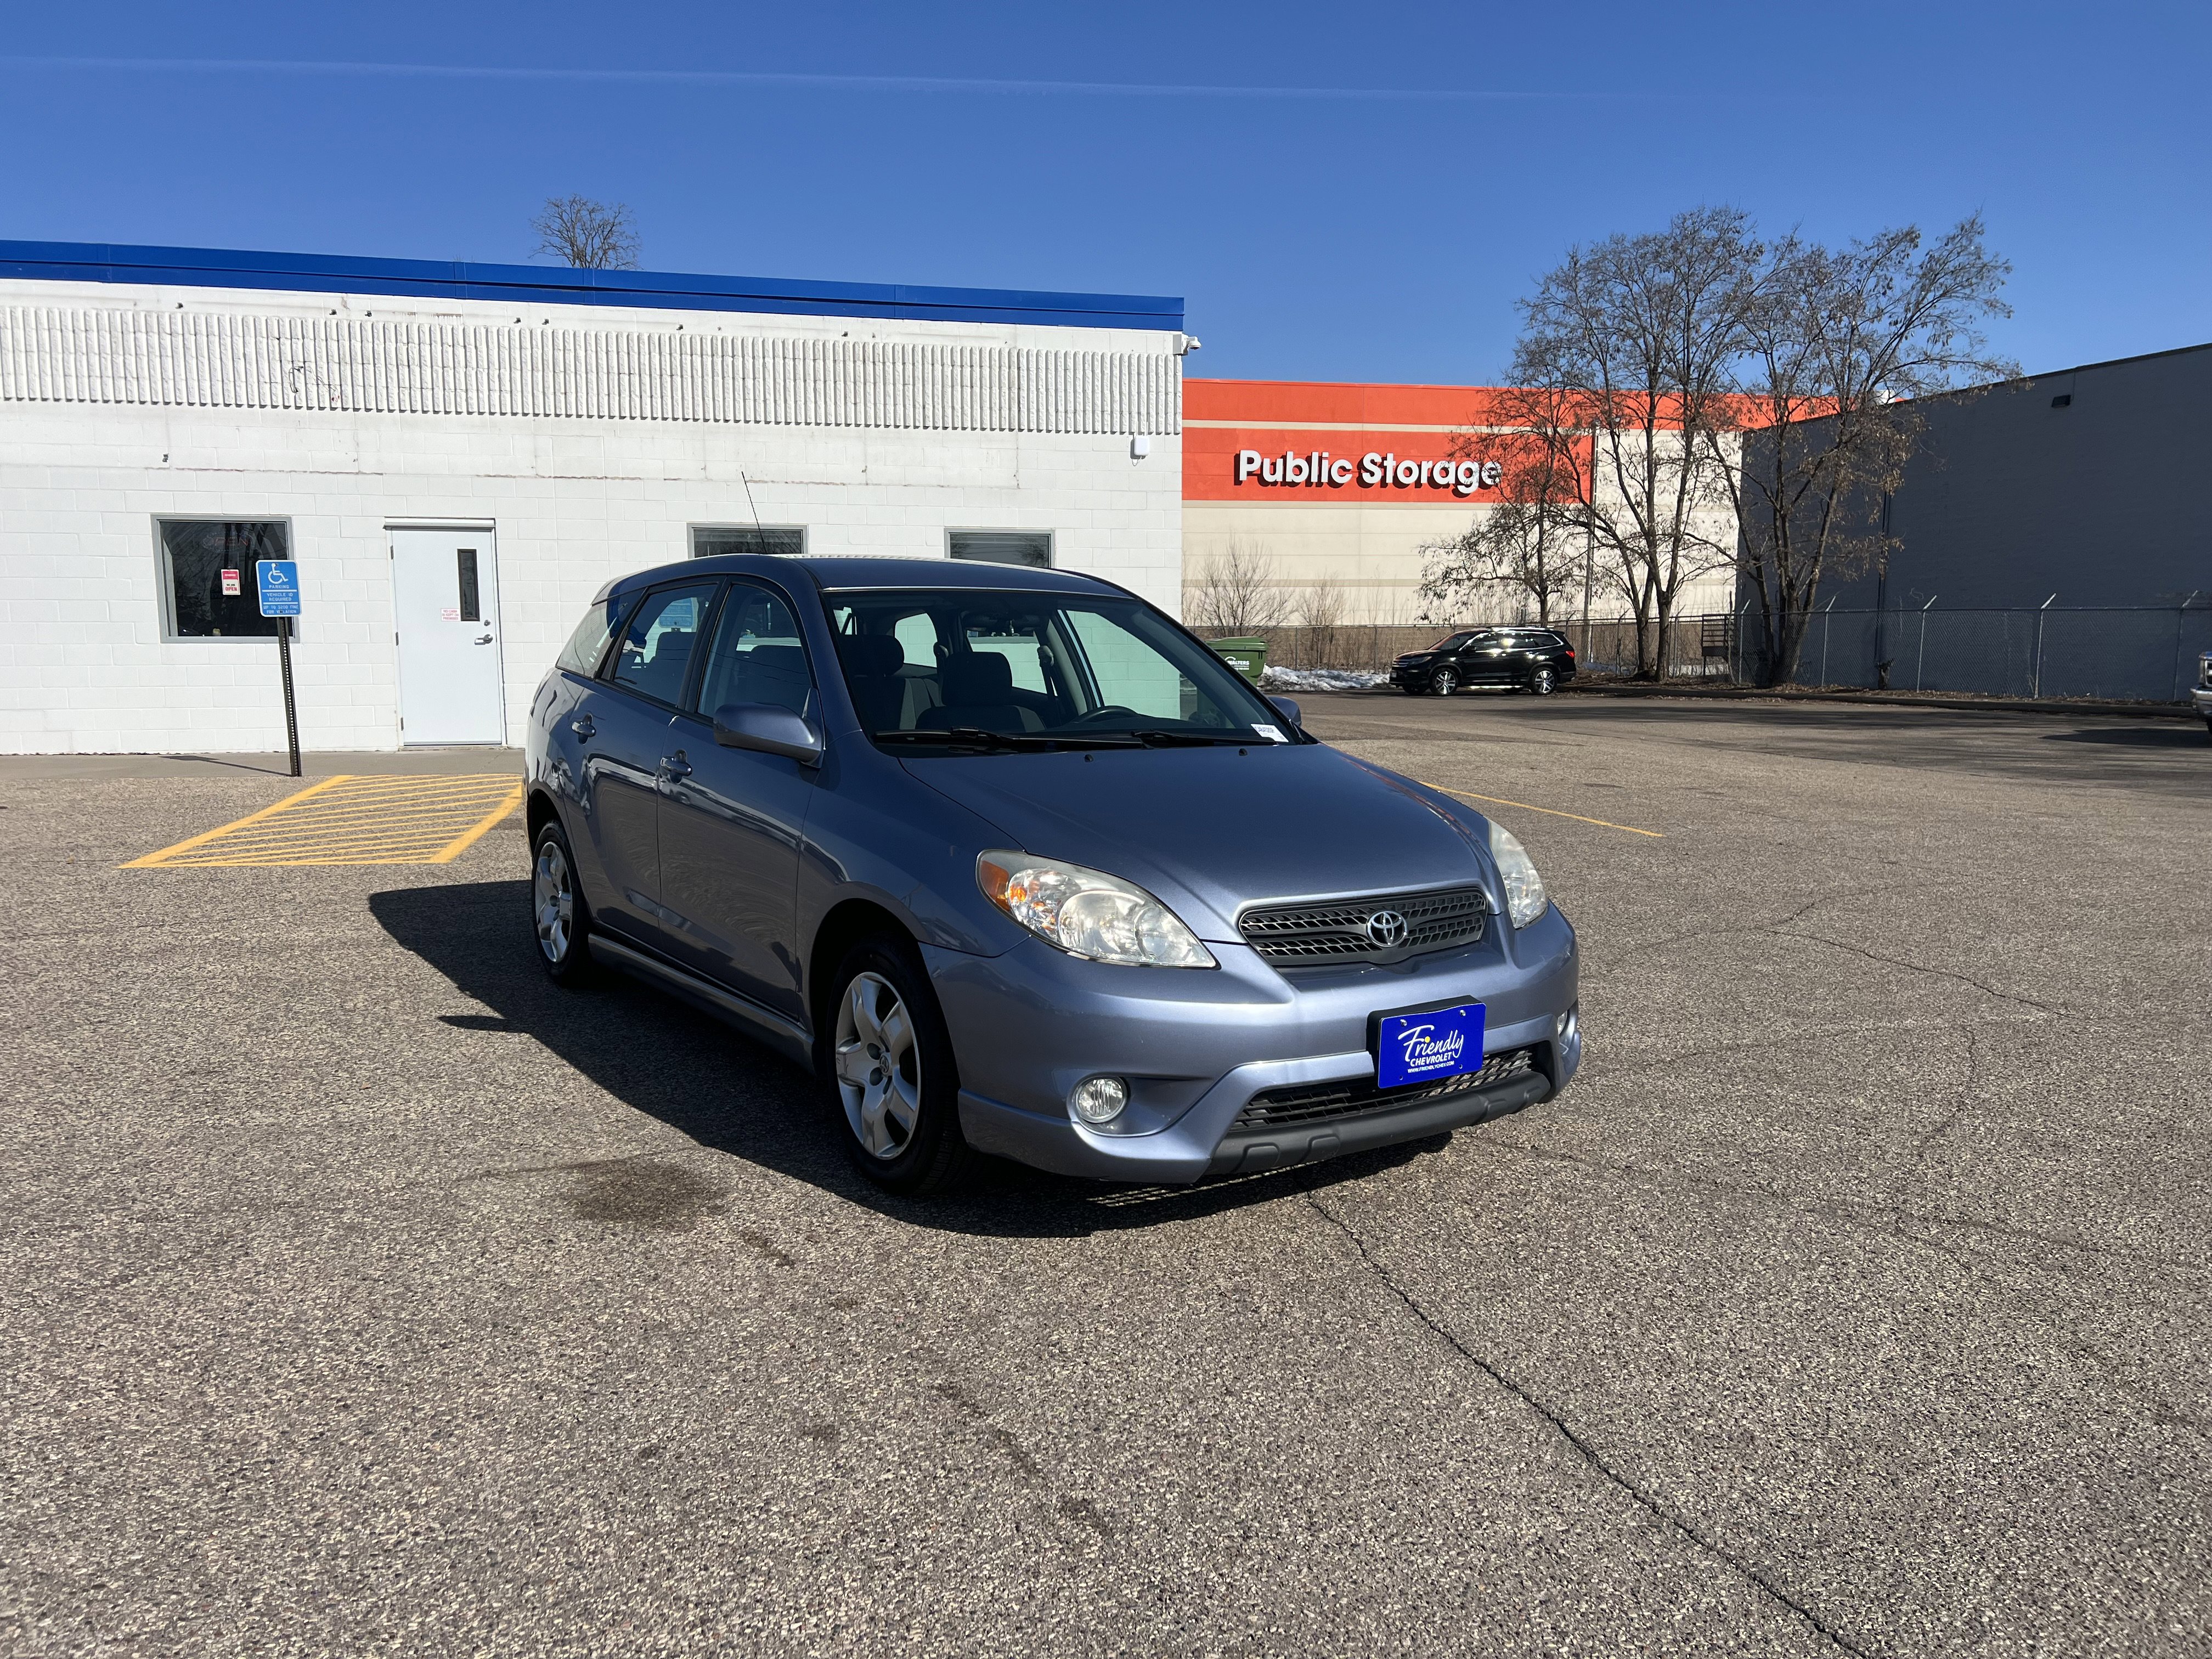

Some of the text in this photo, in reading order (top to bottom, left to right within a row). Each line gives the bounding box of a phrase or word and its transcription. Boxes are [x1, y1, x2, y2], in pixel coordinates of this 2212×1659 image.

[1239, 450, 1502, 494] Public Storage
[1398, 1025, 1464, 1062] Friendly
[1410, 1051, 1453, 1068] CHEVROLET
